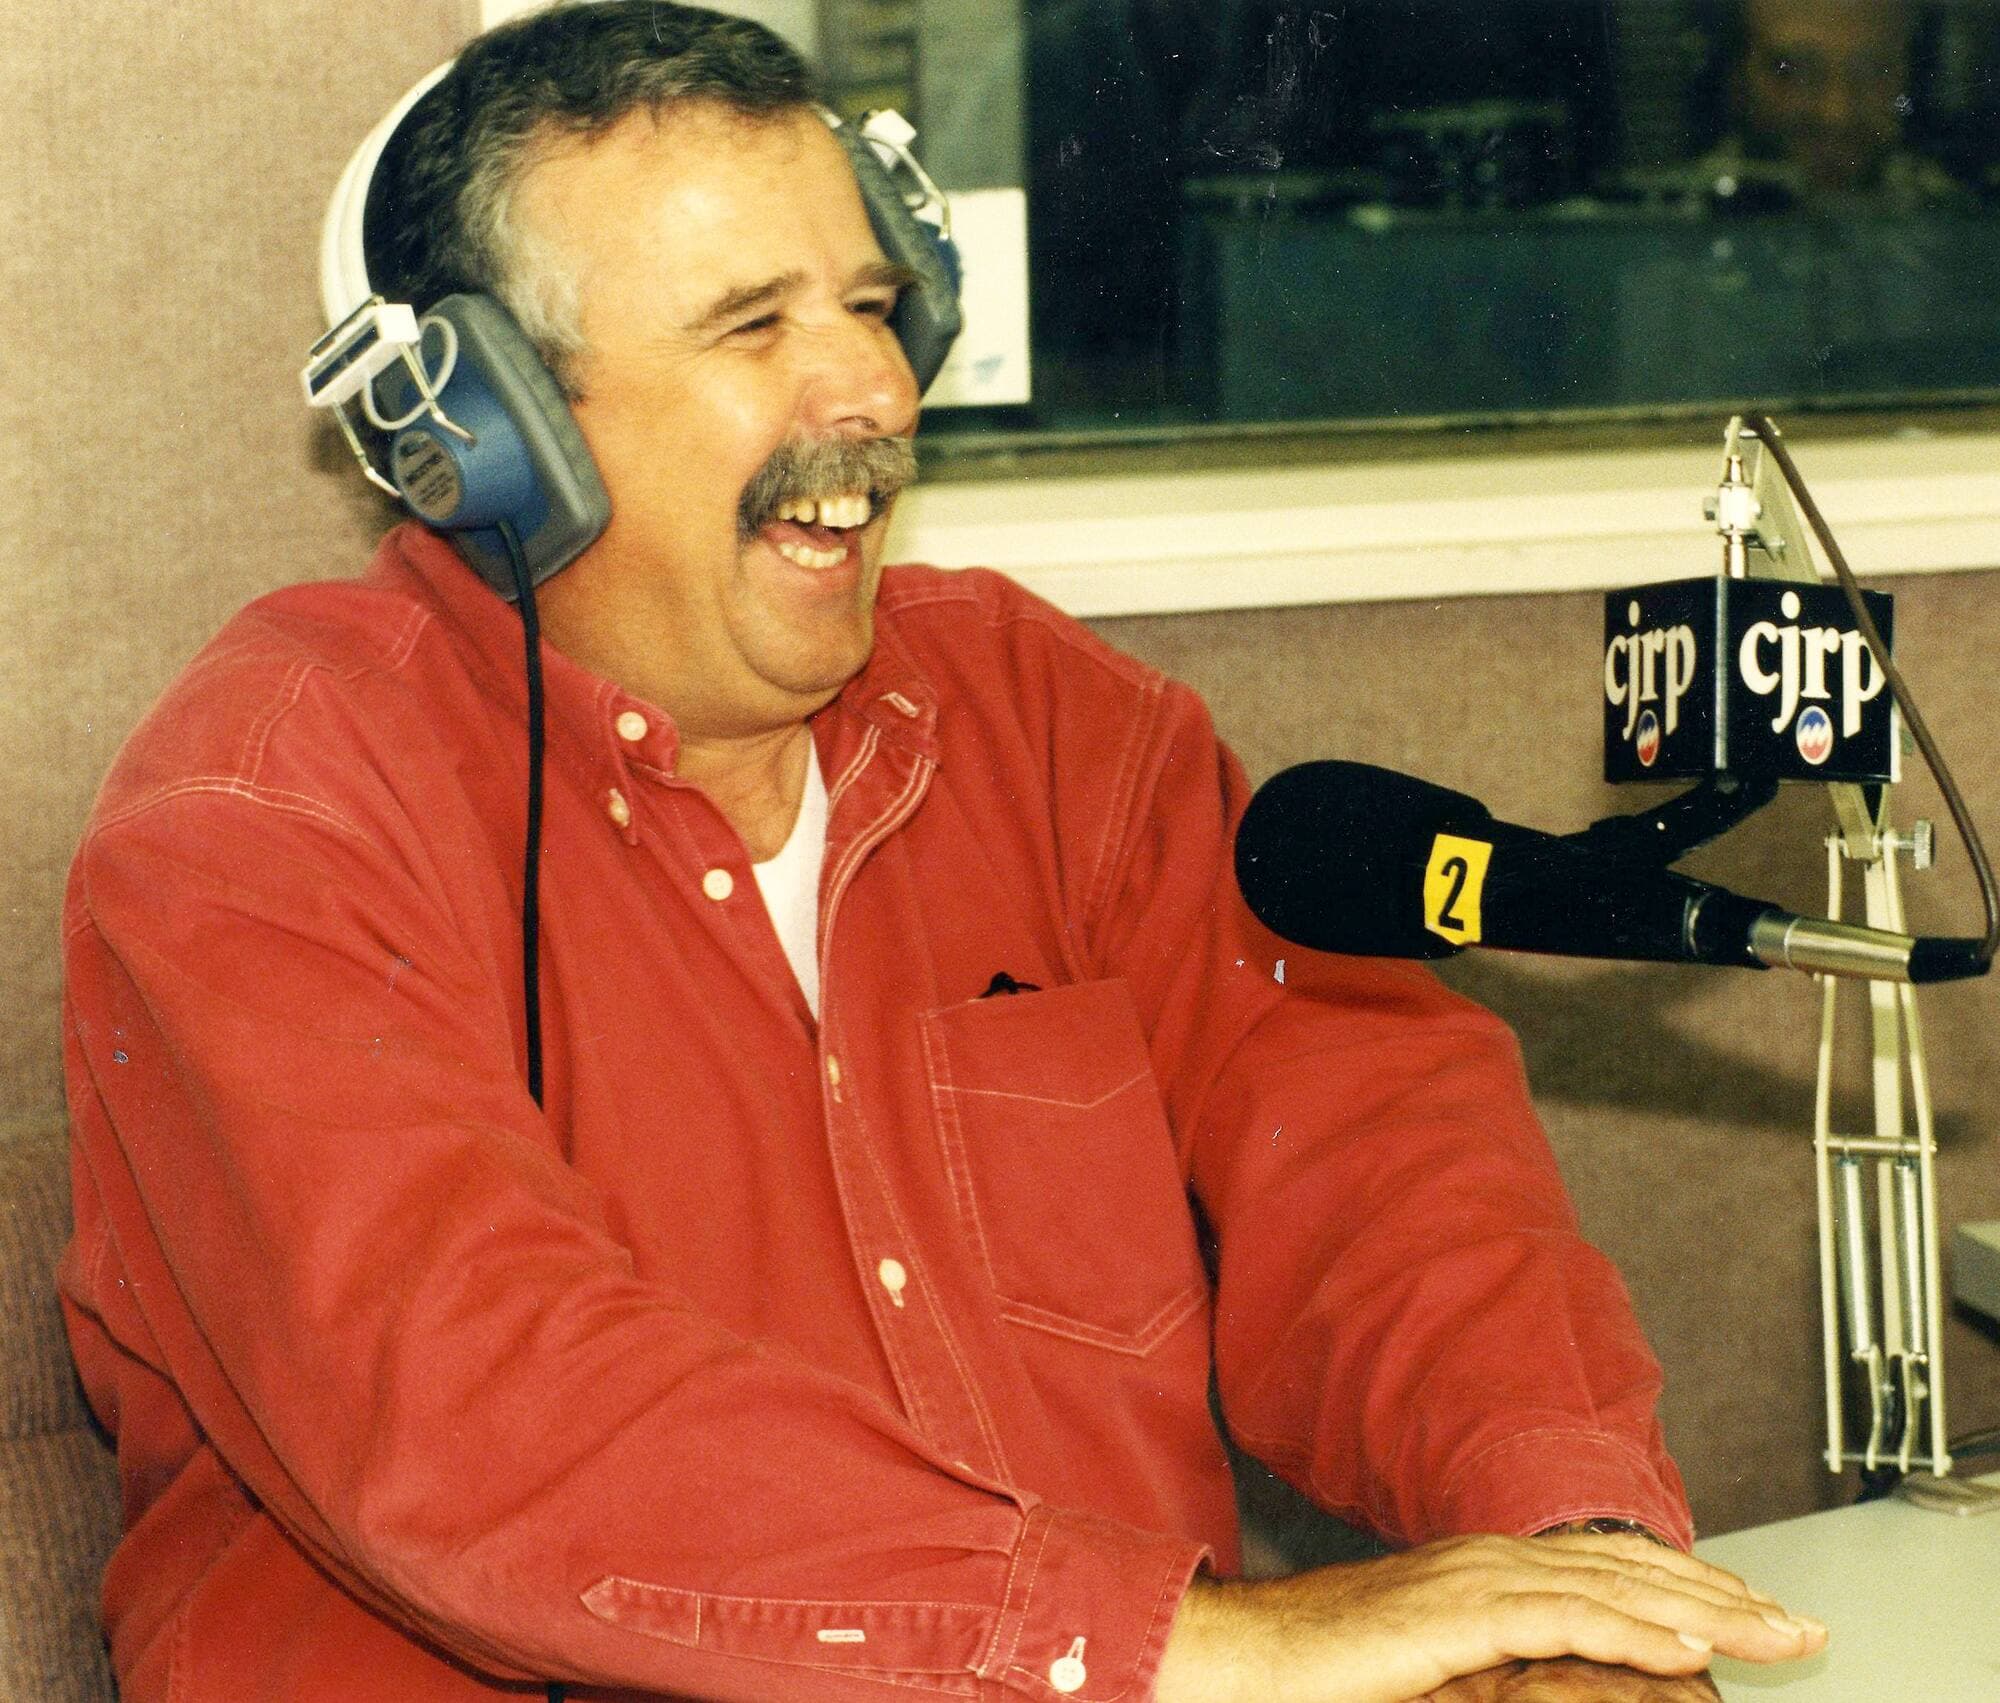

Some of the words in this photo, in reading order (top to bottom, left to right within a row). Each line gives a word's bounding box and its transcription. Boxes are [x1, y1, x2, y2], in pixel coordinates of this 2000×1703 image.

[1605, 600, 1697, 741] cjrp
[1739, 591, 1886, 738] cjrp
[1438, 857, 1468, 932] 2
